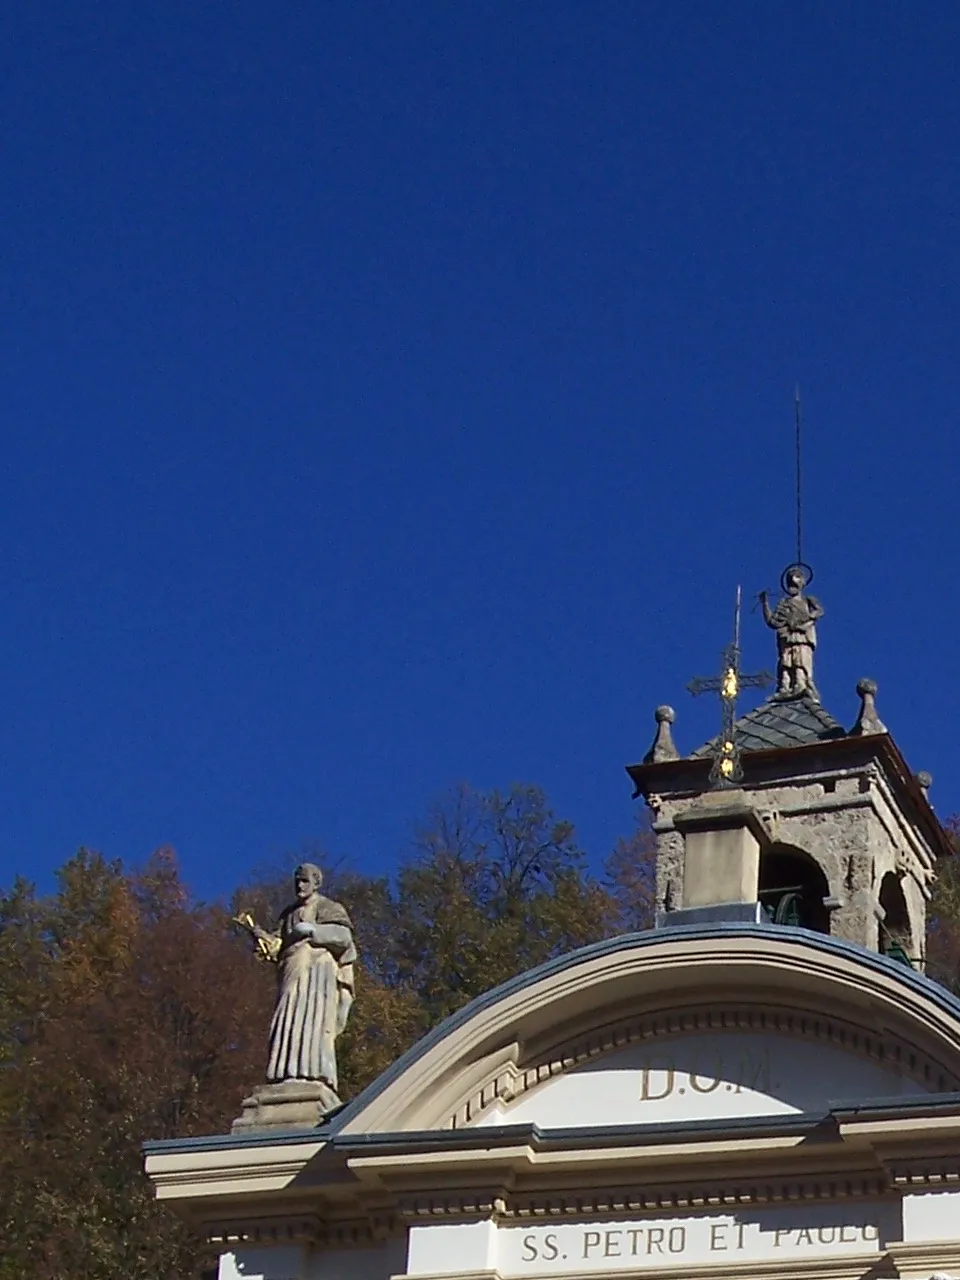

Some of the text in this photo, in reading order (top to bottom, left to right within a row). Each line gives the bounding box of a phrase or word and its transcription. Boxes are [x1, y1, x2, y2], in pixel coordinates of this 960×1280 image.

[521, 1214, 880, 1262] SS. PETRO ET PAULO
